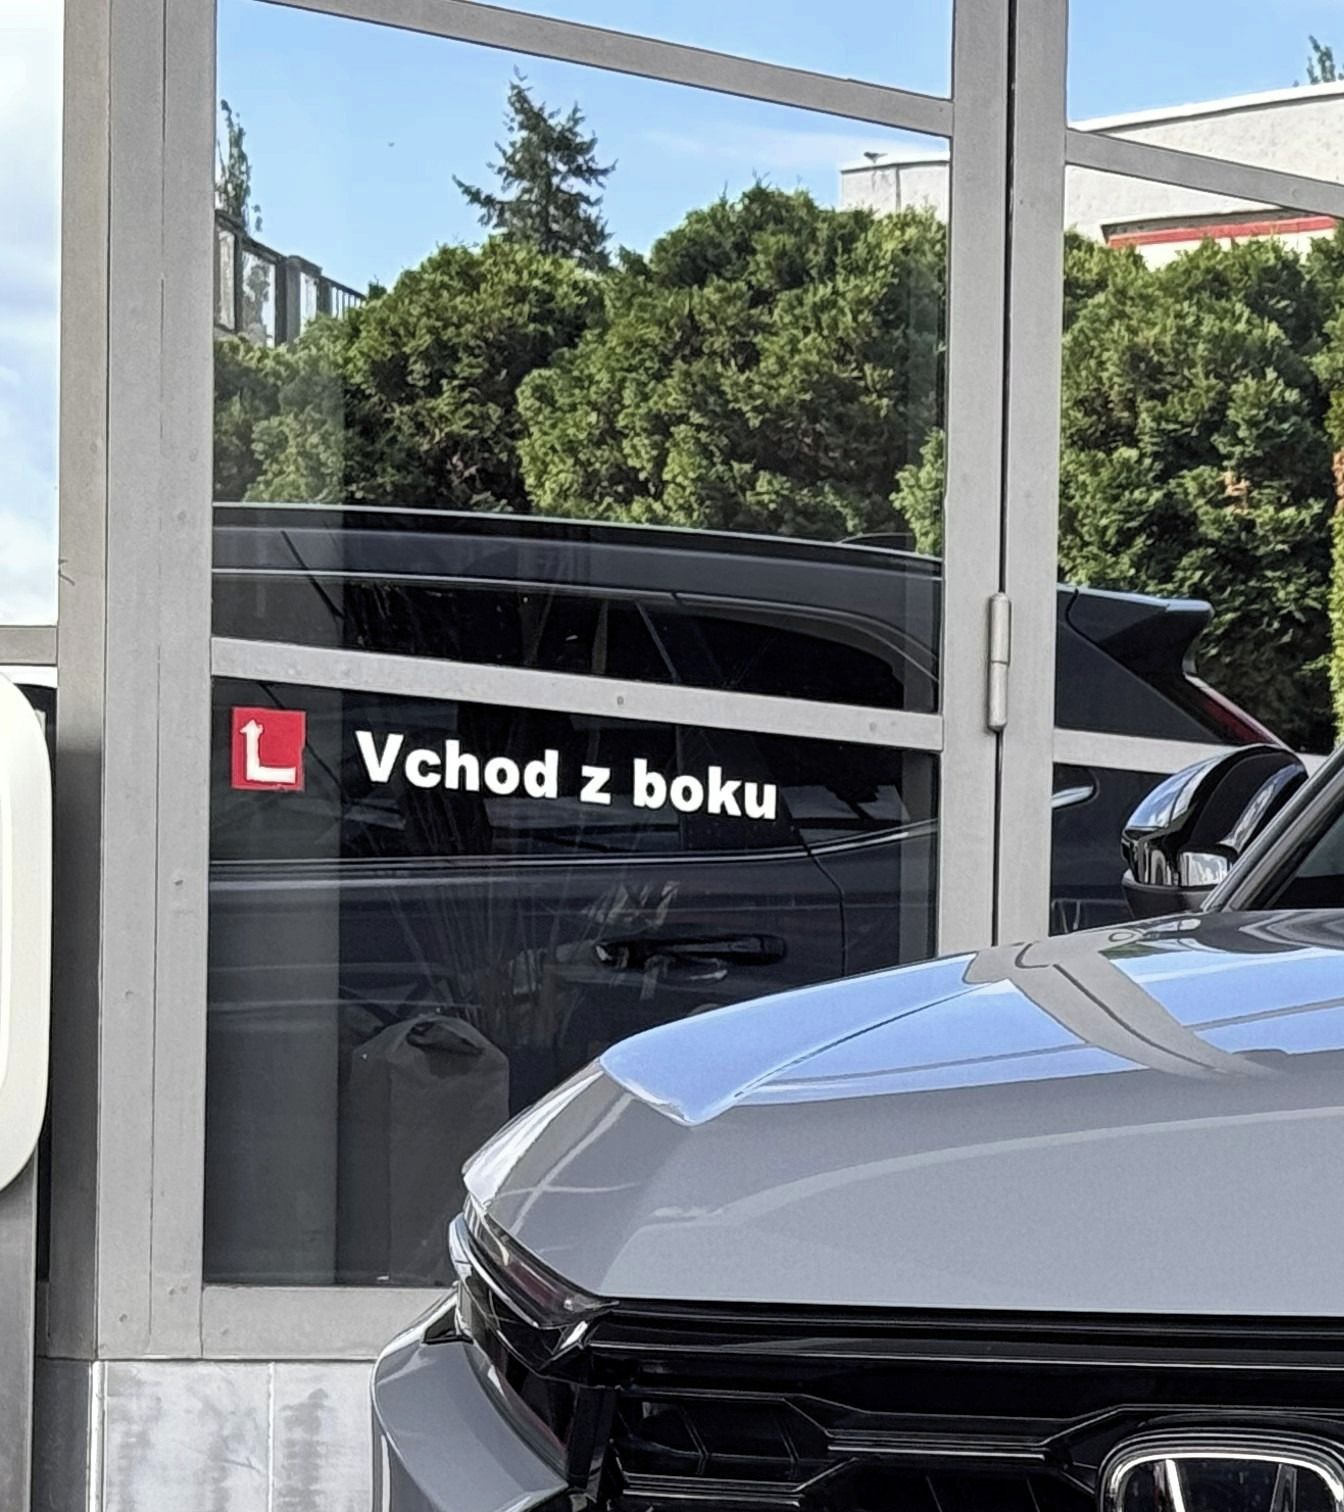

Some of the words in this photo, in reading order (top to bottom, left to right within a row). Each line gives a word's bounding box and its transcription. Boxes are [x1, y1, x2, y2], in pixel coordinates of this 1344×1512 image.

[355, 730, 560, 798] Vchod
[580, 765, 611, 805] z
[633, 758, 778, 819] boku
